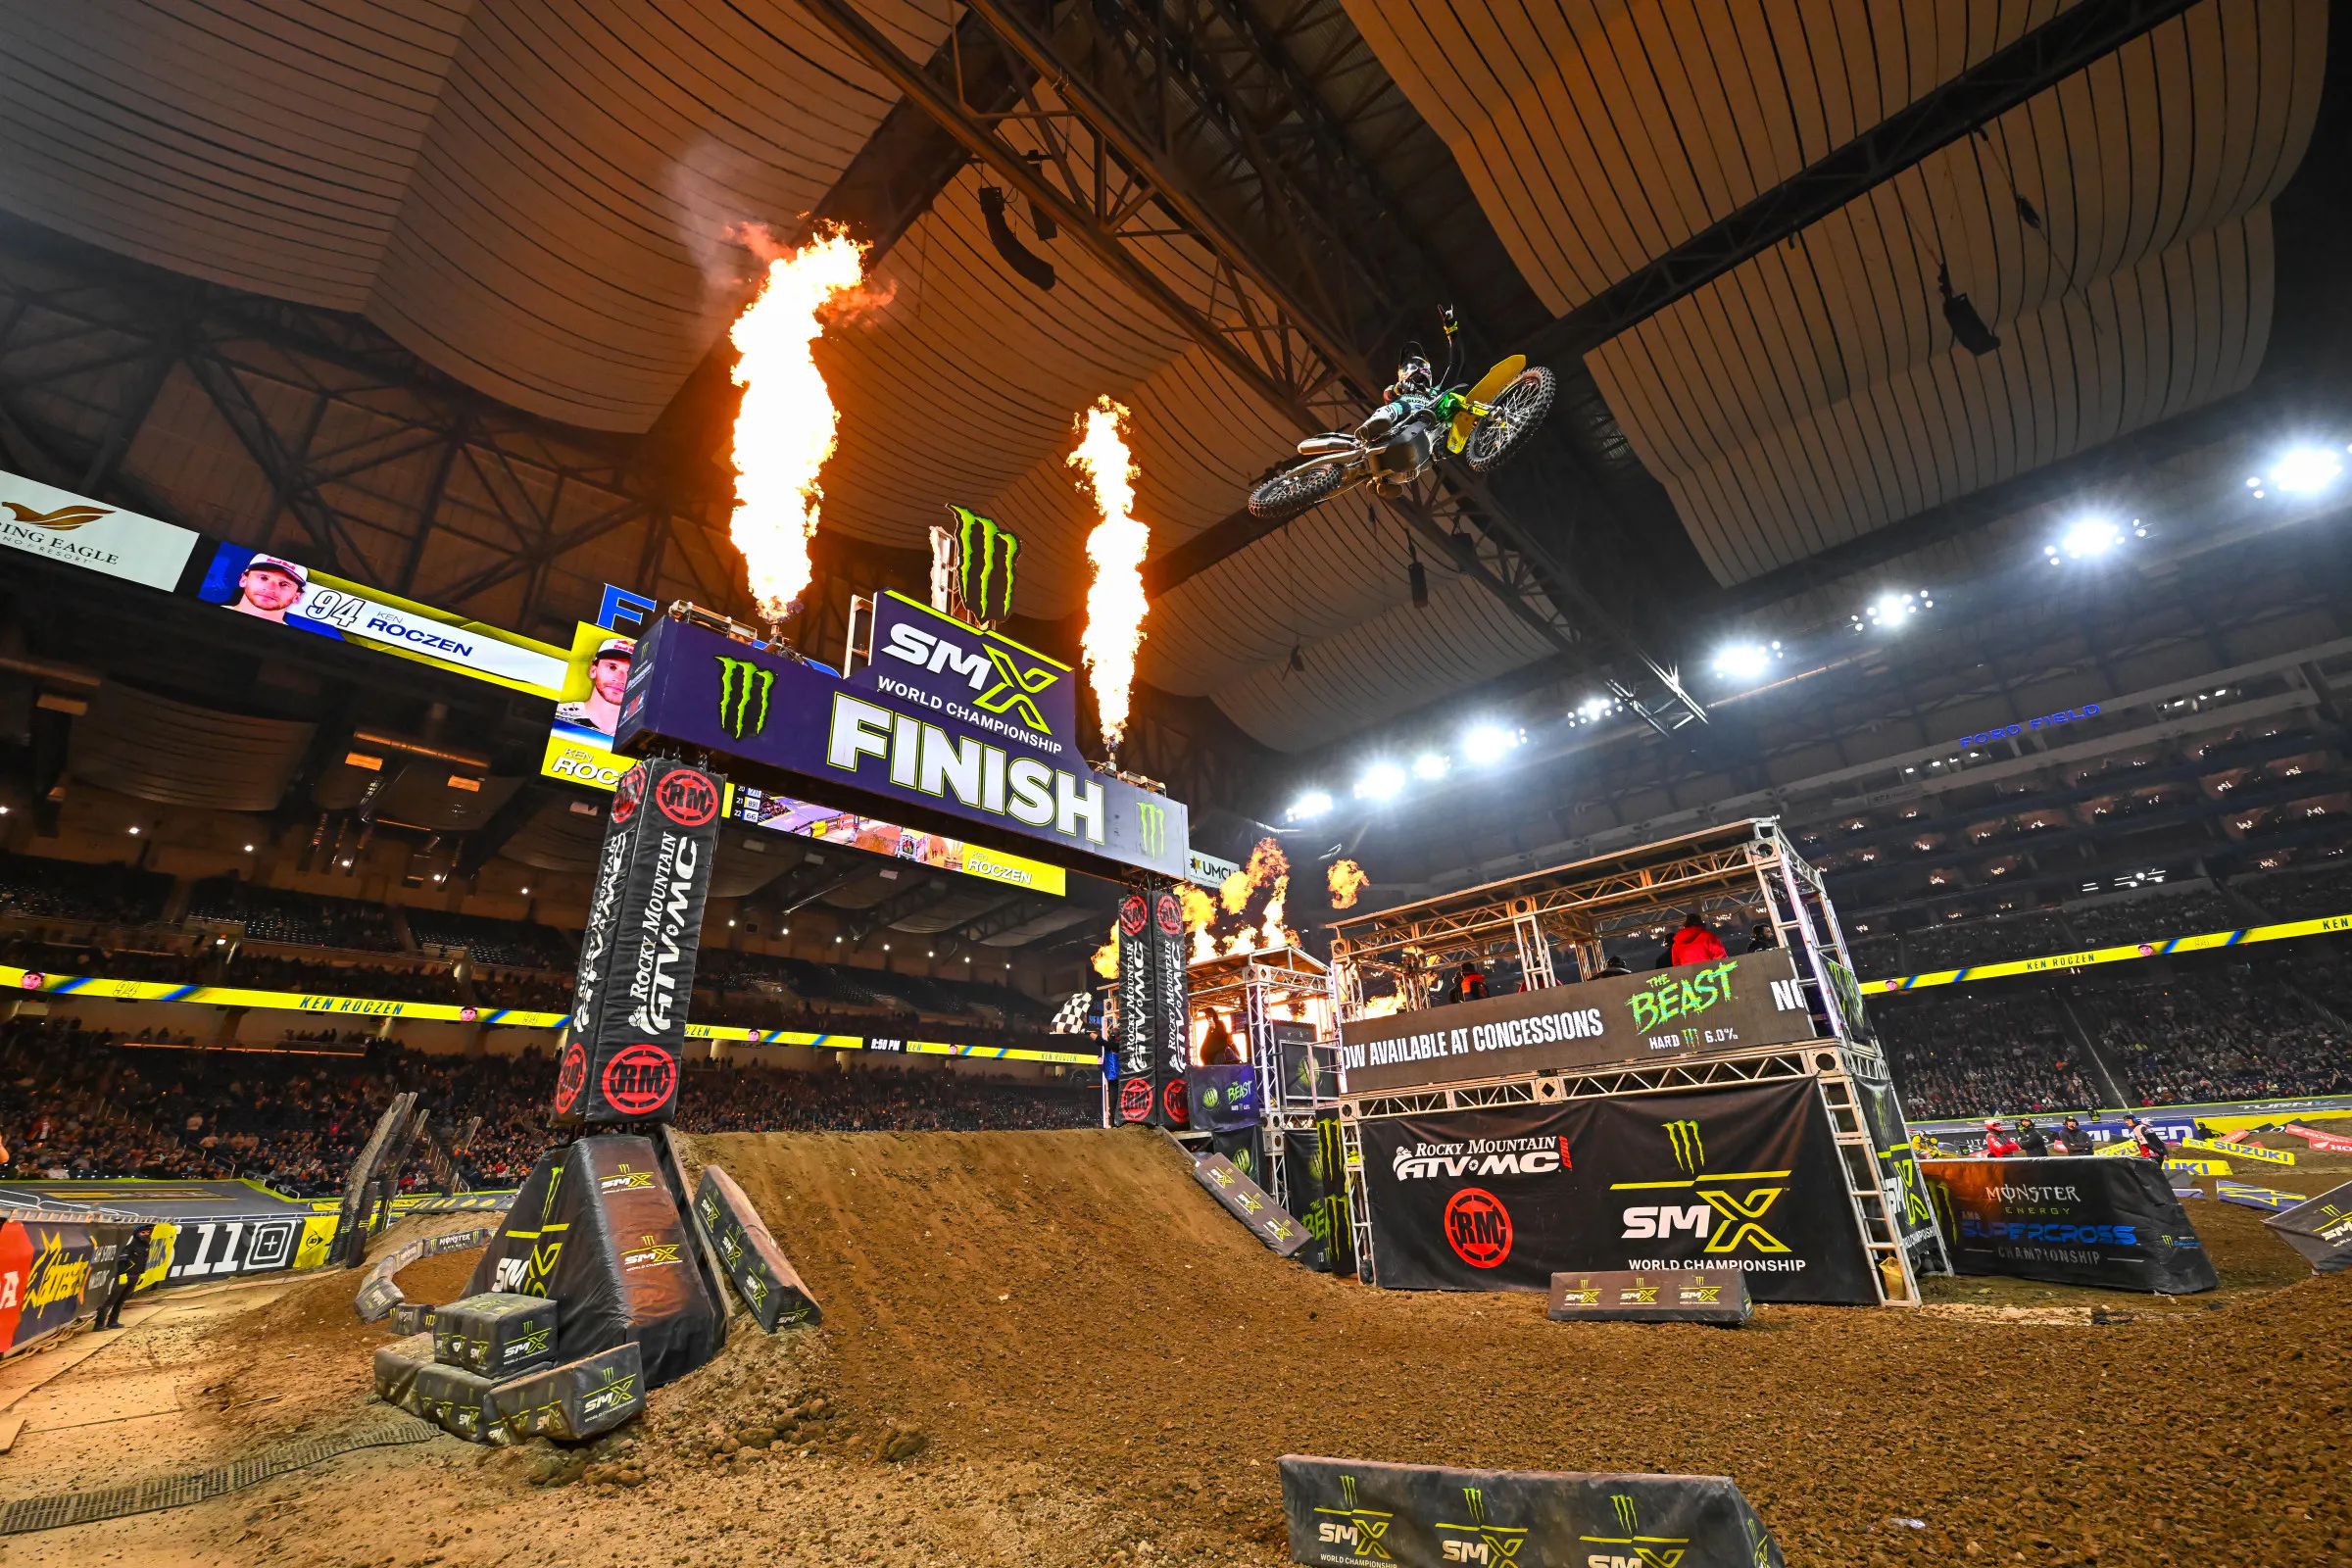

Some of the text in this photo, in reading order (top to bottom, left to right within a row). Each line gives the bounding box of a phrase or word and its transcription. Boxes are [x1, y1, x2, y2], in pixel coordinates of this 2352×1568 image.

[0, 521, 120, 565] ING EAGLE
[2, 535, 24, 545] NO
[38, 545, 90, 564] RESORT
[306, 590, 366, 628] 94
[376, 611, 404, 624] KEN
[367, 617, 473, 658] ROCZEN
[881, 622, 1059, 736] SMX
[878, 675, 1062, 755] WORLD CHAMPIONSHIP
[1959, 704, 2101, 749] FORD FIELD
[564, 748, 595, 762] KEN
[552, 756, 626, 786] ROC
[826, 690, 1105, 846] FINISH
[967, 858, 1033, 884] ROCZEN
[629, 831, 677, 1003] ROCKY MOUNTAIN
[2322, 917, 2350, 930] KEN
[2027, 953, 2095, 971] KEN ROCZEN
[112, 980, 141, 998] 94
[1646, 972, 1671, 988] THE
[299, 996, 404, 1016] KEN ROCZEN
[1126, 943, 1137, 1052] ROCKY MOUNTAIN
[1165, 939, 1177, 1050] ROCKY MOUNTAIN
[1624, 960, 1739, 1037] BEAST
[1770, 978, 1805, 1012] NO
[684, 1026, 711, 1037] CZEN
[1344, 1007, 1604, 1070] OW AVAILABLE AT CONCESSIONS
[1648, 1027, 1739, 1051] HARD 6.0%
[888, 1039, 901, 1052] PM
[1226, 1080, 1253, 1104] BEAST
[1415, 1142, 1465, 1157] ROCKY
[1466, 1136, 1557, 1155] MOUNTAIN
[2213, 1141, 2289, 1163] SUZUKI
[601, 1174, 653, 1189] SMX
[1984, 1183, 2082, 1203] MONSTER
[1621, 1187, 1793, 1253] SMX
[1962, 1210, 1981, 1221] AMA
[2004, 1206, 2071, 1216] ENERGY
[439, 1233, 470, 1246] MONSTER
[1962, 1221, 2138, 1246] SUPERCROSS
[2321, 1217, 2352, 1242] SM
[169, 1222, 244, 1277] .11
[624, 1247, 680, 1265] SMX
[1997, 1246, 2101, 1265] CHAMPIONSHIP
[1628, 1258, 1807, 1272] WORLD CHAMPIONSHIP
[1565, 1290, 1601, 1303] SMX
[1620, 1289, 1657, 1302] SMX
[1680, 1289, 1721, 1301] SMX
[503, 1332, 549, 1358] SMX
[583, 1380, 634, 1413] SMX
[1318, 1518, 1392, 1560] SMX
[1442, 1534, 1525, 1568] SMX
[1320, 1553, 1398, 1568] WORLD CHAMPIONSHIP
